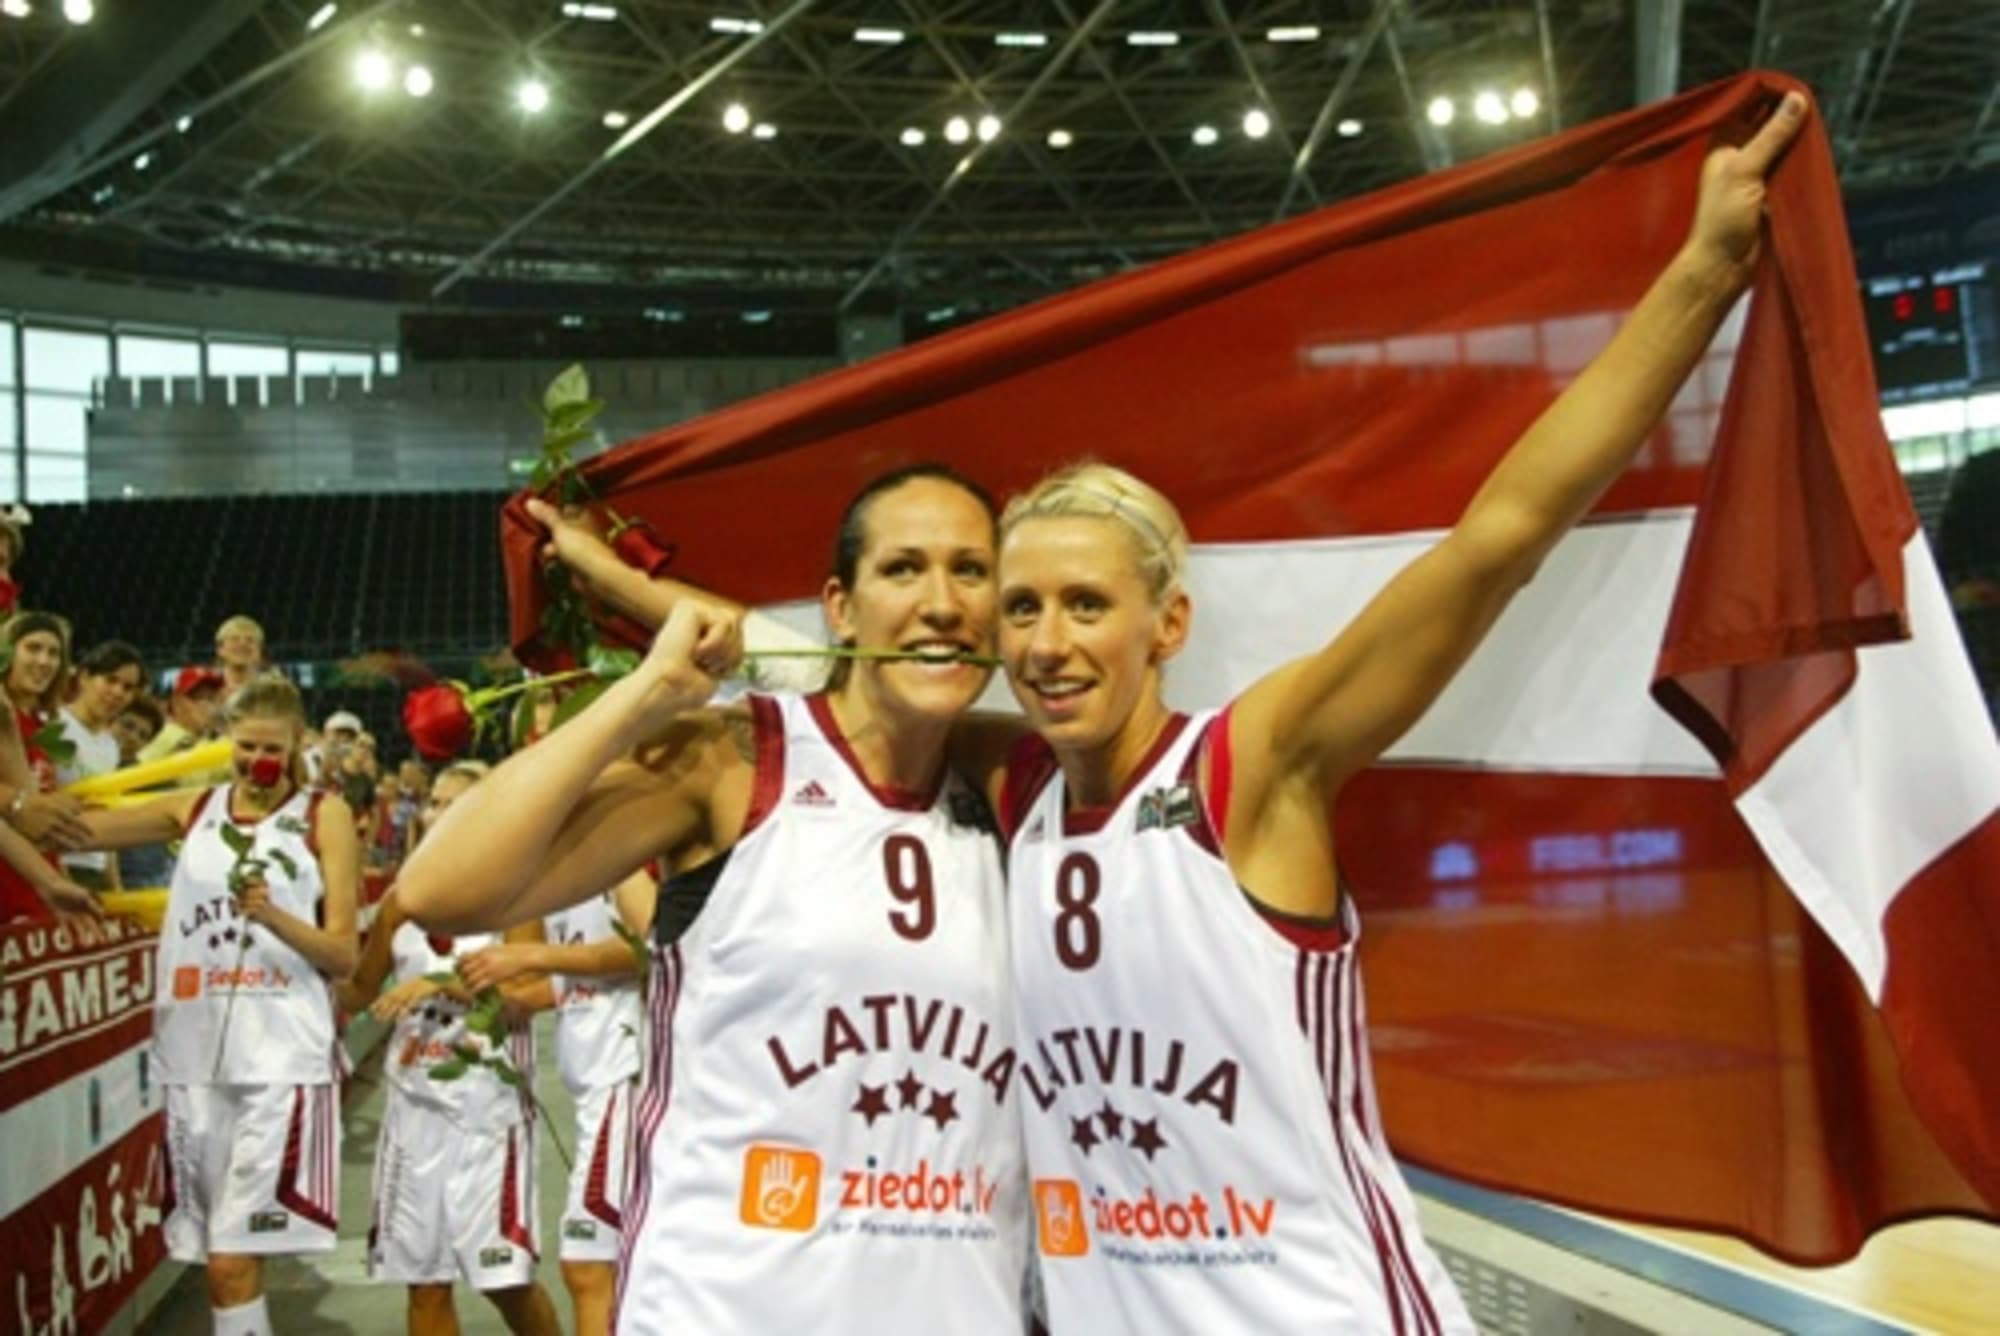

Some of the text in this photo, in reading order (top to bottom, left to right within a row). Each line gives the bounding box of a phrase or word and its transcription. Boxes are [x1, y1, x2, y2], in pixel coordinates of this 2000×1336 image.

[882, 834, 936, 942] 9
[1054, 851, 1101, 971] 8
[767, 995, 1017, 1105] LATVIJA
